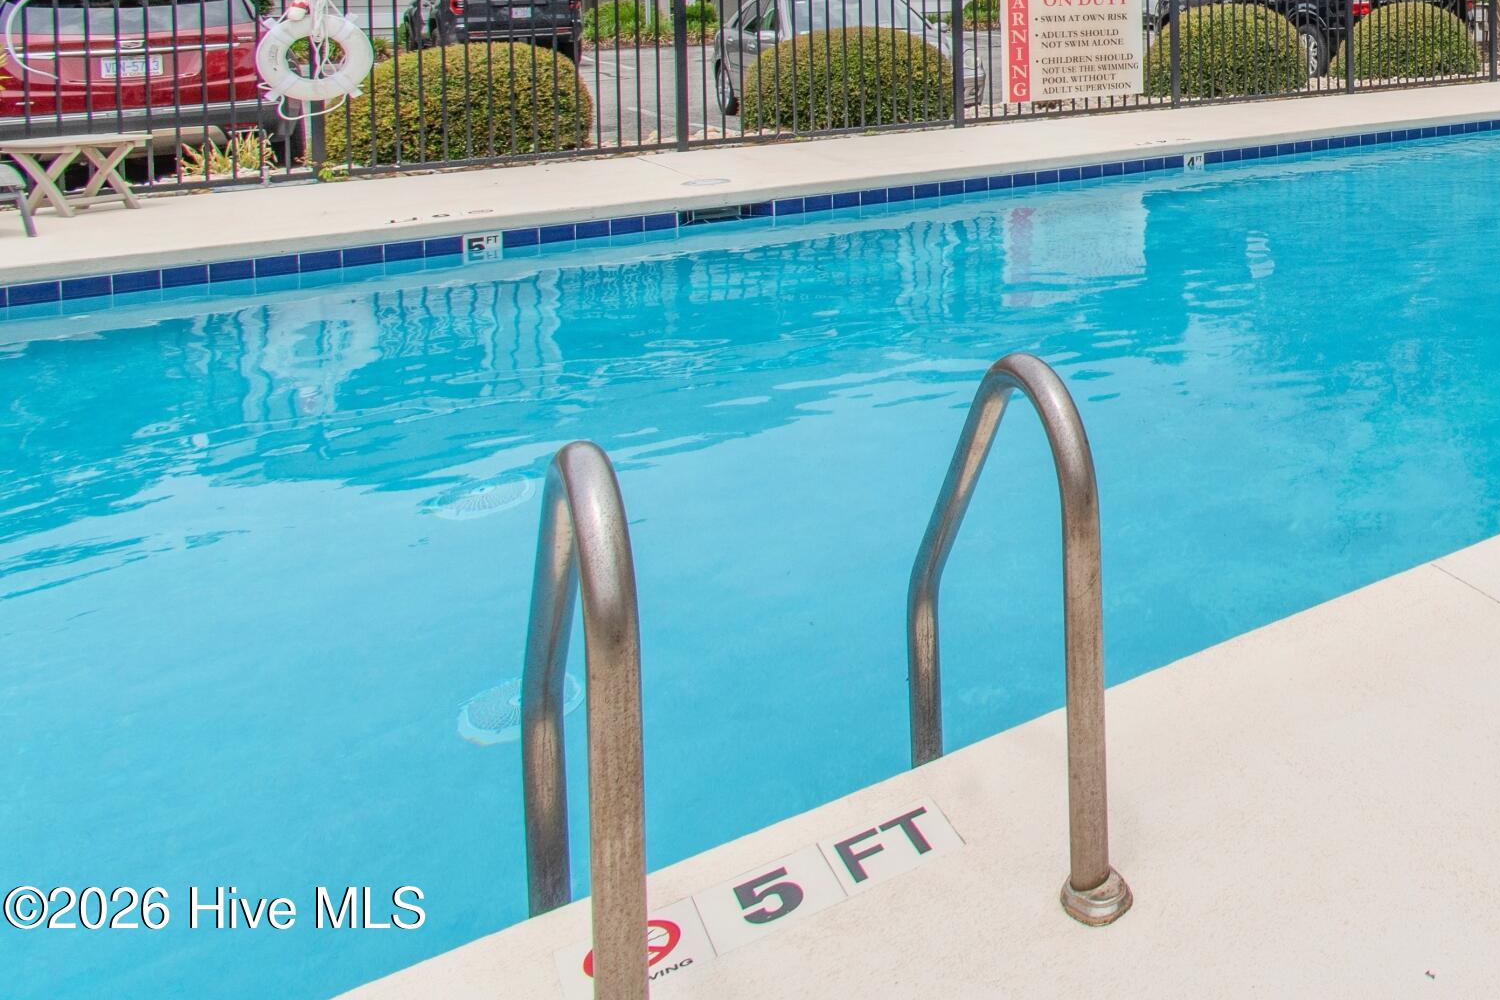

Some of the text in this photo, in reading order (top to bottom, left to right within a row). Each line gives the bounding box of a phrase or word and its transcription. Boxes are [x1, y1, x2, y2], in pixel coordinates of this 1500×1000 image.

[1040, 13, 1128, 23] SWIM AT OWN RISK
[1041, 29, 1119, 39] ADULTS SHOULD
[1041, 38, 1124, 49] NOT SWIM ALONE
[1041, 53, 1133, 65] CHILDREN SHOULD
[1042, 67, 1061, 75] NOT
[1097, 63, 1139, 71] SWIMMING
[1042, 74, 1117, 85] POOL WITHOUT
[1042, 83, 1132, 95] ADULT SUPERVISION
[468, 235, 499, 251] 5 FT
[733, 806, 932, 924] 5 FT
